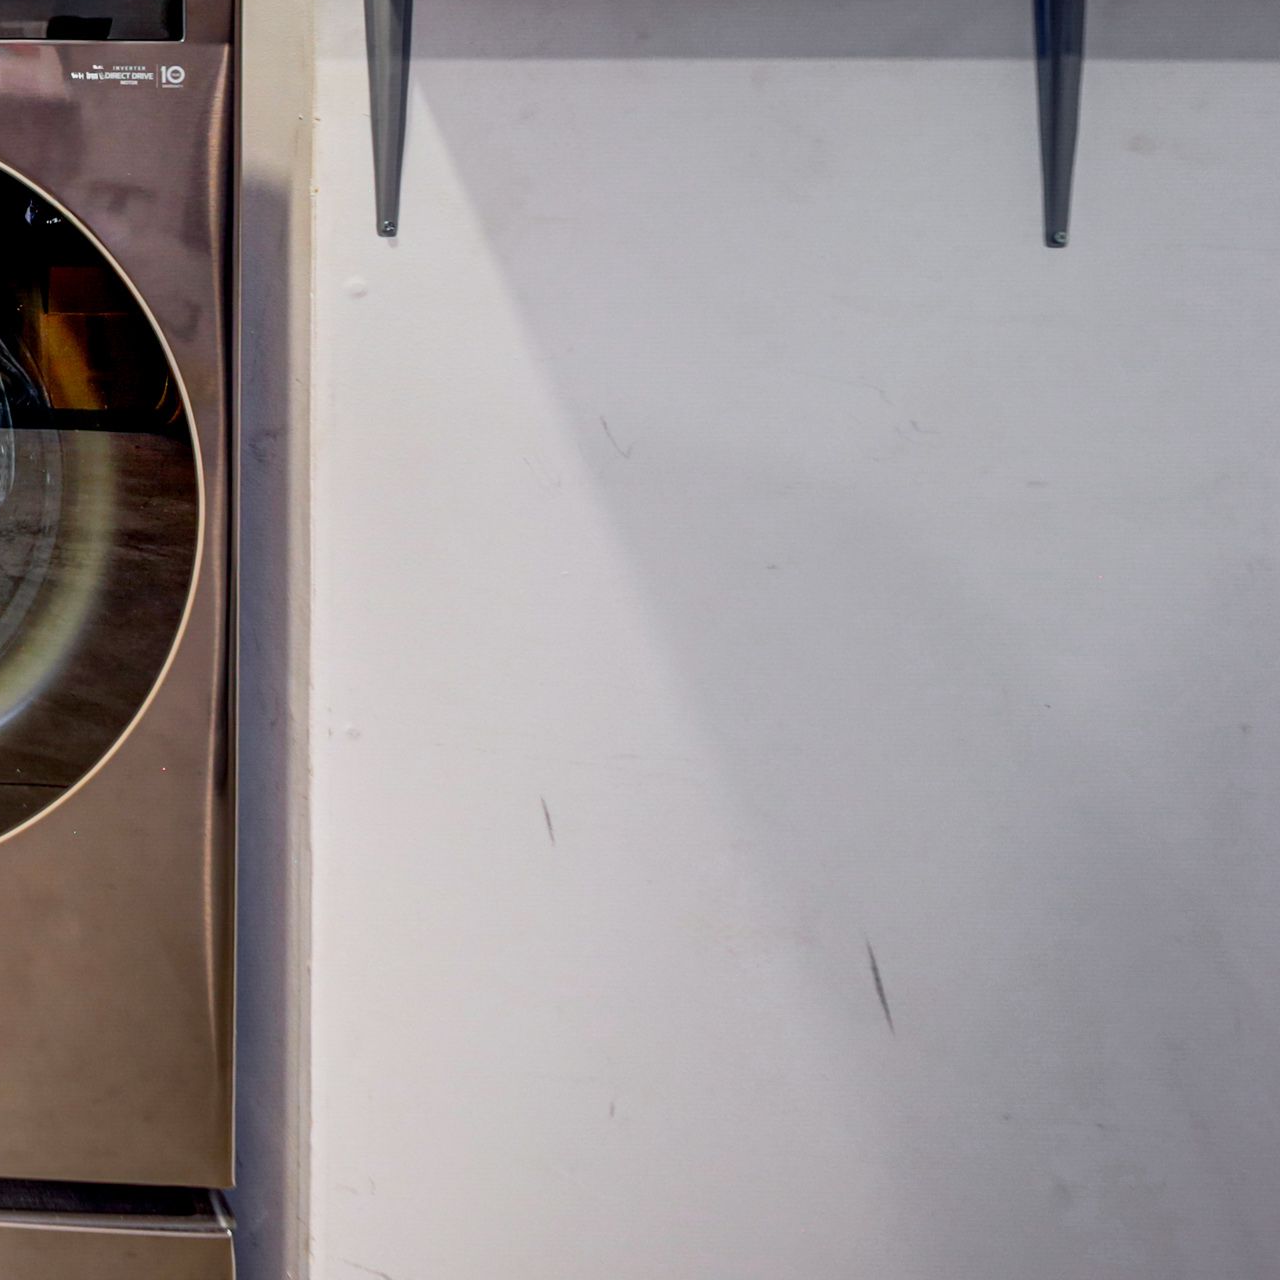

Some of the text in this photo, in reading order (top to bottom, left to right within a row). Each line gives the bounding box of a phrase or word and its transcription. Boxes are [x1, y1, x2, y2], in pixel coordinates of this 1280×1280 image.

[104, 72, 130, 80] DIRECT
[131, 72, 154, 80] DRIVE
[160, 65, 185, 84] 10
